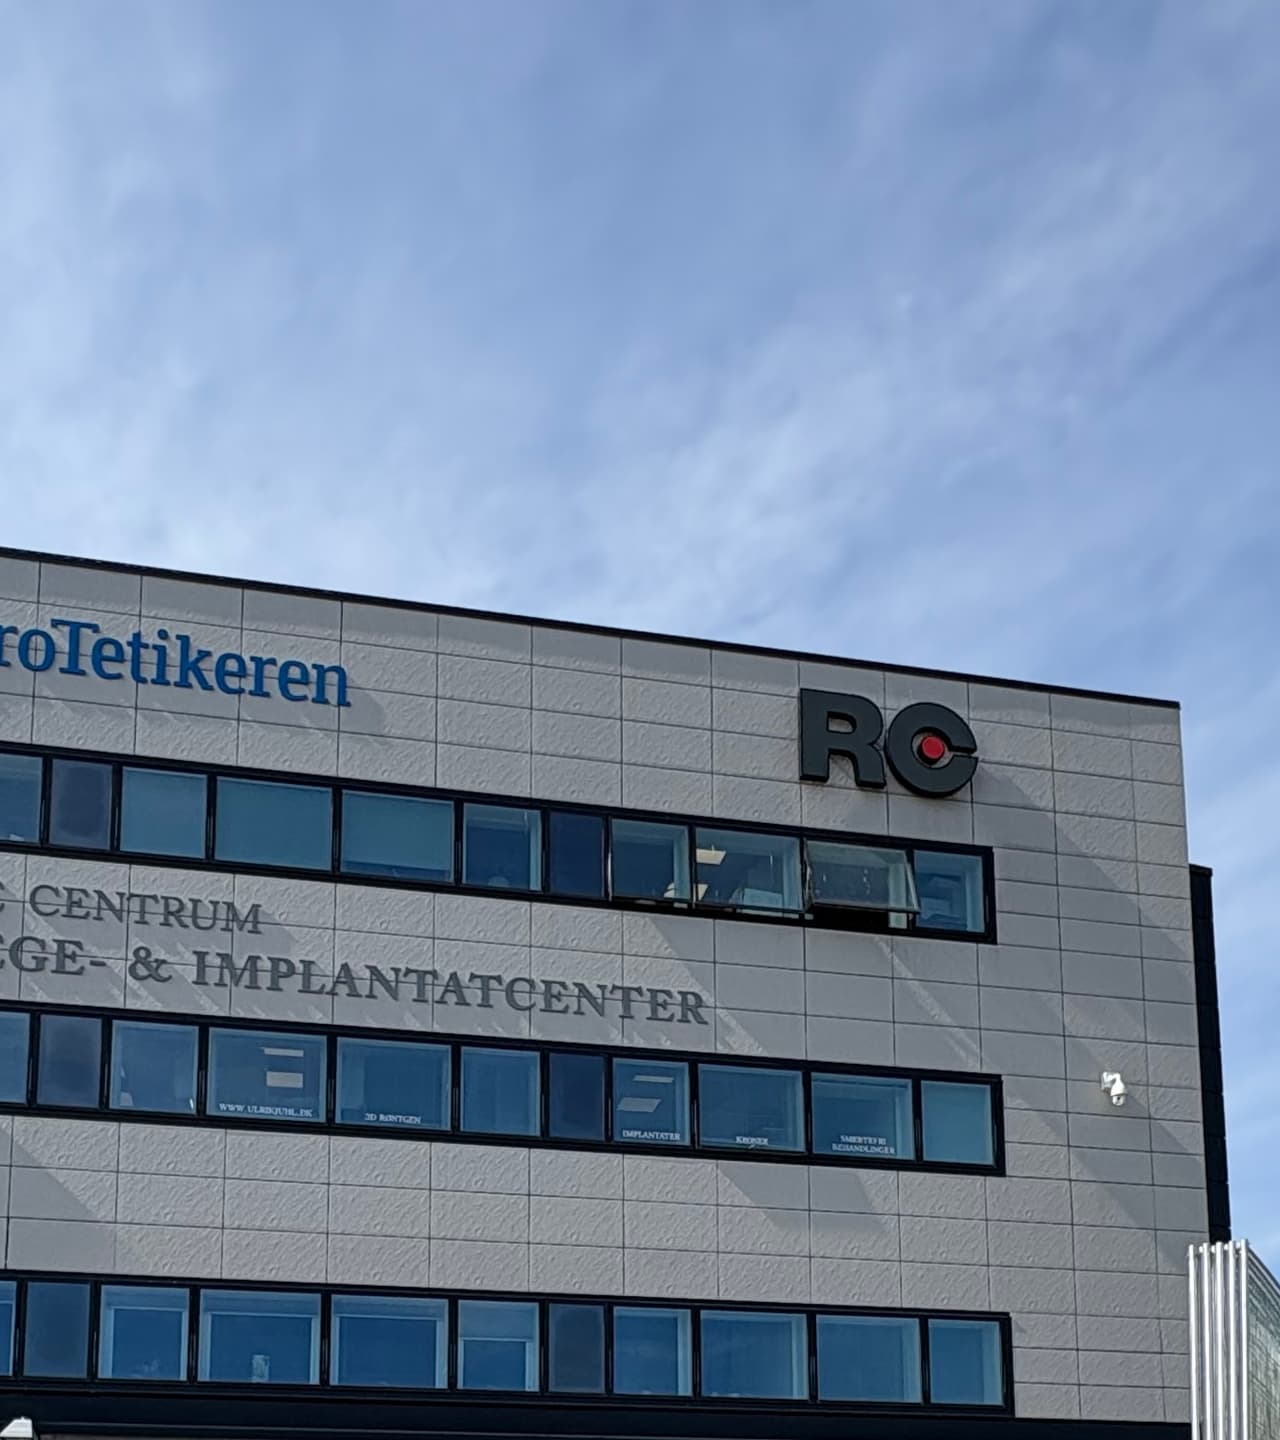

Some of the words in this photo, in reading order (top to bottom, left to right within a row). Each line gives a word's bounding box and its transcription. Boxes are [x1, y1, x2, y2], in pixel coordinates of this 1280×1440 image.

[798, 687, 980, 799] RC
[28, 883, 263, 935] CENTRUM
[127, 944, 175, 983] &
[191, 948, 710, 1025] IMPLANTATCENTER
